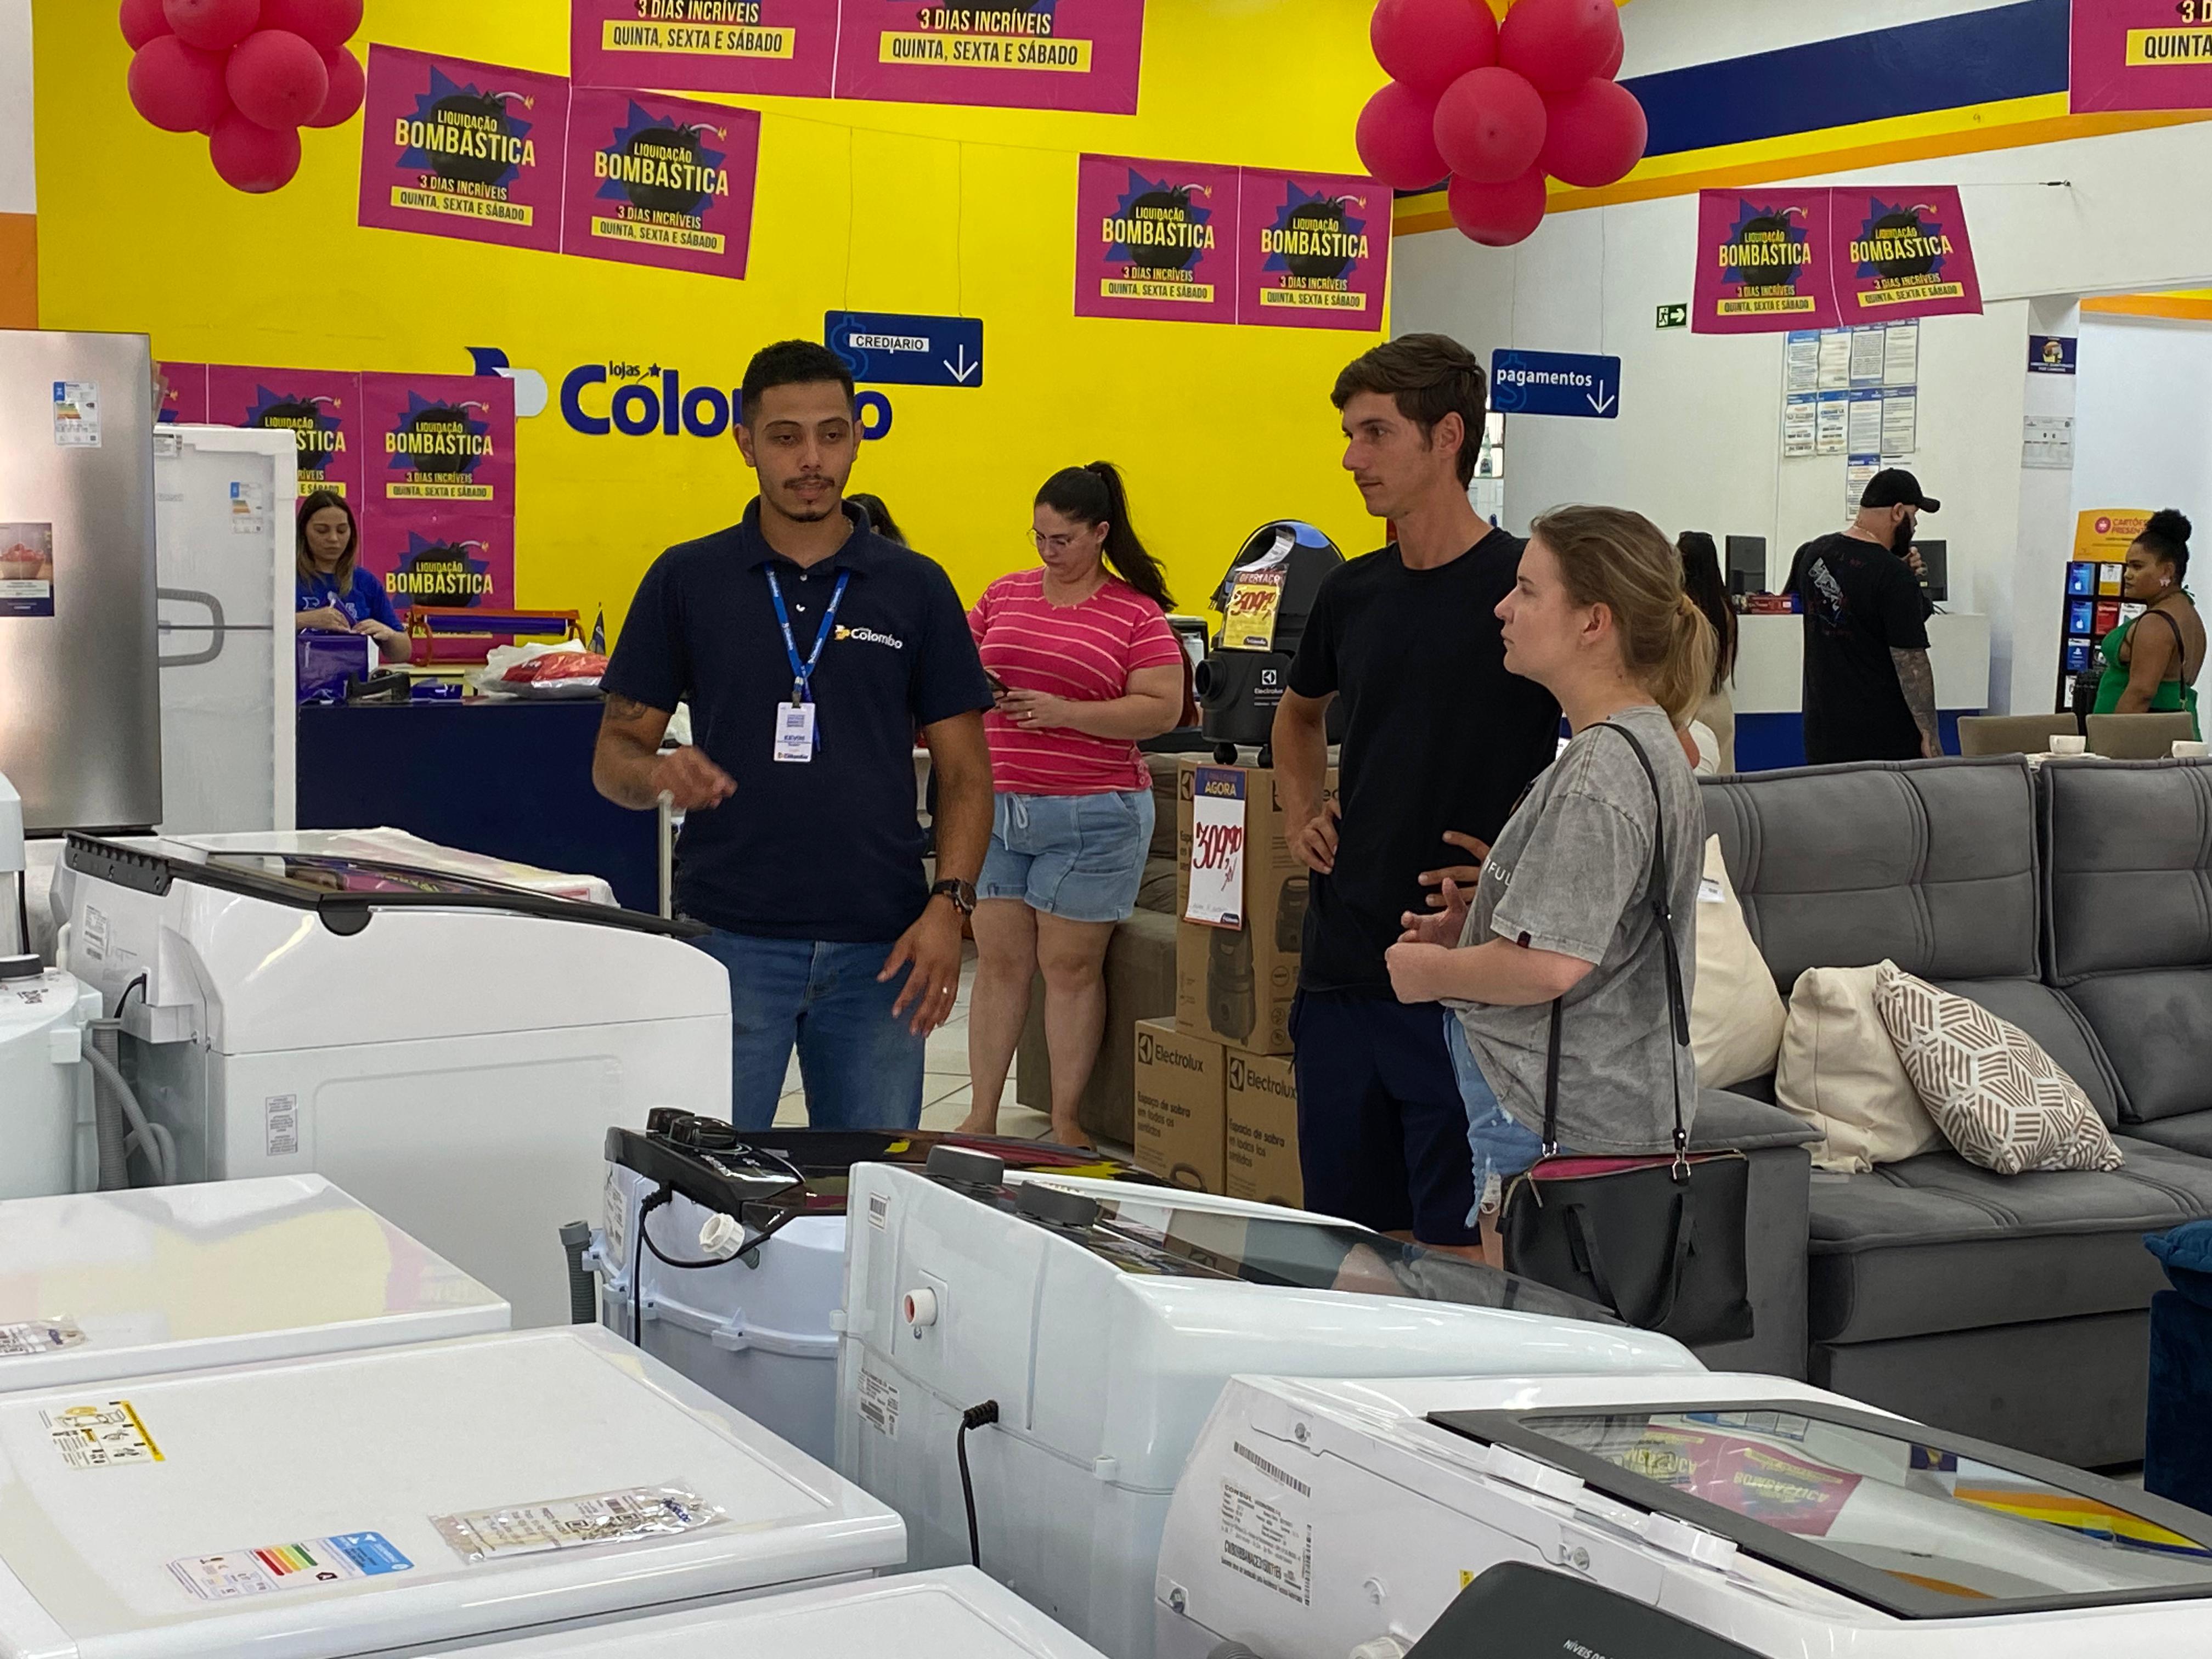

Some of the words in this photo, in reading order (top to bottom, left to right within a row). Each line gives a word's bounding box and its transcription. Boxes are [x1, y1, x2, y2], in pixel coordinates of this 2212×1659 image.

[637, 0, 647, 20] 3
[651, 0, 683, 21] DIAS
[687, 0, 759, 24] INCRÍVEIS
[920, 8, 930, 30] 3
[934, 9, 970, 31] DIAS
[973, 8, 1052, 34] INCRÍVEIS
[2182, 0, 2194, 23] 3
[613, 27, 663, 50] QUINTA,
[667, 29, 710, 50] SEXTA
[714, 31, 723, 50] E
[726, 27, 783, 53] SÁBADO
[892, 37, 948, 63] QUINTA,
[953, 41, 1000, 63] SEXTA
[1004, 43, 1013, 63] E
[1018, 38, 1079, 66] SÁBADO
[438, 110, 497, 132] LIQUIDAÇÃO
[395, 119, 535, 167] BOMBÁSTICA
[634, 143, 692, 164] LIQUIDAÇÃO
[595, 150, 729, 196] BOMBÁSTICA
[420, 175, 427, 188] 3
[430, 176, 453, 193] DIAS
[454, 177, 507, 200] INCRÍVEIS
[400, 192, 439, 210] QUINTA,
[443, 196, 473, 213] SEXTA
[477, 202, 483, 214] E
[486, 201, 524, 221] SÁBADO
[1136, 206, 1184, 223] LIQUIDAÇÃO
[617, 206, 625, 218] 3
[627, 207, 649, 222] DIAS
[653, 208, 701, 229] INCRÍVEIS
[1293, 217, 1339, 233] LIQUIDAÇÃO
[600, 221, 637, 239] QUINTA,
[640, 225, 669, 242] SEXTA
[672, 230, 678, 242] E
[680, 229, 718, 250] SÁBADO
[1102, 217, 1215, 250] BOMBÁSTICA
[1261, 227, 1369, 258] BOMBÁSTICA
[1745, 229, 1785, 245] LIQUIDAÇÃO
[1875, 226, 1917, 240] LIQUIDAÇÃO
[1719, 240, 1812, 267] BOMBÁSTICA
[1849, 235, 1954, 263] BOMBÁSTICA
[1123, 267, 1130, 279] 3
[1131, 267, 1151, 280] DIAS
[1153, 267, 1193, 282] INCRÍVEIS
[1280, 276, 1286, 287] 3
[1288, 276, 1306, 289] DIAS
[1308, 276, 1347, 290] INCRÍVEIS
[1874, 279, 1880, 289] 3
[1881, 276, 1899, 289] DIAS
[1901, 271, 1941, 285] INCRÍVEIS
[1108, 283, 1140, 295] QUINTA,
[1142, 284, 1168, 297] SEXTA
[1170, 286, 1175, 297] E
[1176, 285, 1207, 299] SÁBADO
[1267, 291, 1296, 304] QUINTA,
[1299, 293, 1322, 305] SEXTA
[1324, 295, 1329, 305] E
[1331, 293, 1360, 307] SÁBADO
[1737, 286, 1742, 297] 3
[1744, 286, 1759, 296] DIAS
[1762, 284, 1795, 296] INCRÍVEIS
[1865, 292, 1895, 304] QUINTA,
[1897, 288, 1920, 301] SEXTA
[1922, 288, 1926, 298] E
[1928, 284, 1958, 297] SÁBADO
[1724, 301, 1752, 313] QUINTA,
[1754, 301, 1774, 313] SEXTA
[1775, 301, 1780, 312] E
[1781, 298, 1809, 312] SÁBADO
[608, 360, 641, 379] lojas
[1497, 368, 1592, 387] pagamentos
[560, 363, 892, 441] Coloo
[264, 416, 313, 431] LIQUIDAÇÃO
[415, 421, 462, 436] LIQUIDAÇÃO
[297, 431, 346, 452] STICA
[385, 430, 493, 456] BOMBÁSTICA
[298, 468, 324, 481] RÍVEIS
[407, 473, 412, 483] 3
[415, 473, 432, 483] DIAS
[435, 471, 472, 484] INCRÍVEIS
[300, 483, 306, 494] E
[393, 485, 423, 498] QUINTA,
[425, 486, 448, 497] SEXTA
[451, 487, 455, 496] E
[458, 484, 487, 498] SÁBADO
[415, 561, 462, 576] LIQUIDAÇÃO
[385, 569, 493, 595] BOMBÁSTICA
[851, 628, 903, 648] Colombo
[1205, 781, 1237, 797] AGORA
[1155, 1044, 1204, 1073] Electrolux
[1247, 1070, 1296, 1099] Electrolux
